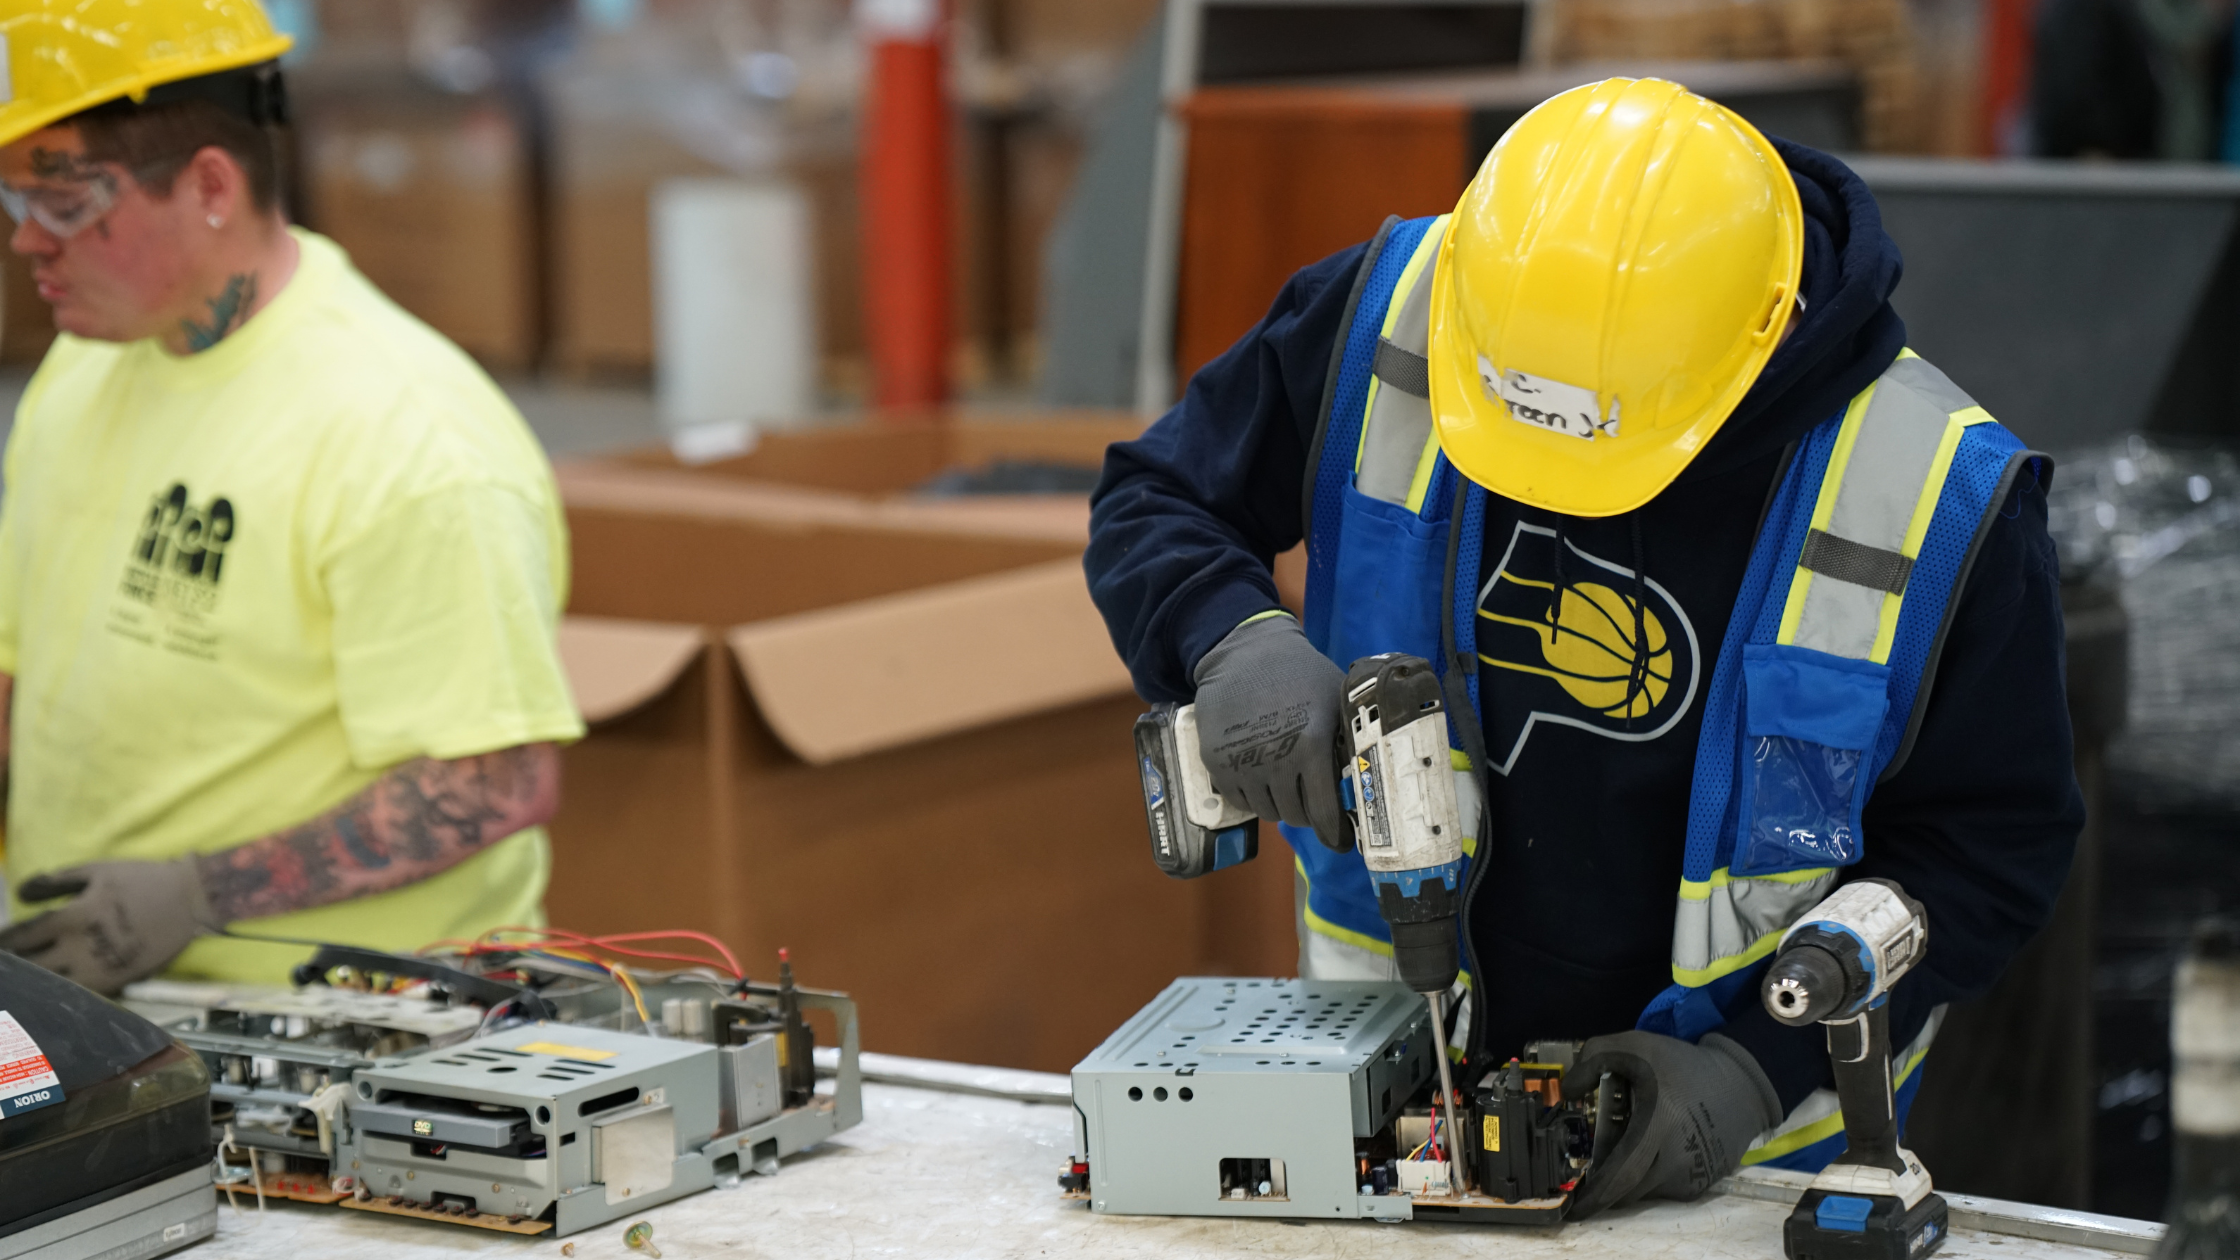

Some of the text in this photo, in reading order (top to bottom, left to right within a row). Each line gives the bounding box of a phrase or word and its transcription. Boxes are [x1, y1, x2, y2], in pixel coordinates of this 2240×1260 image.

[1228, 732, 1301, 772] G-Tek
[1155, 811, 1170, 857] HART
[13, 1090, 51, 1108] ORION
